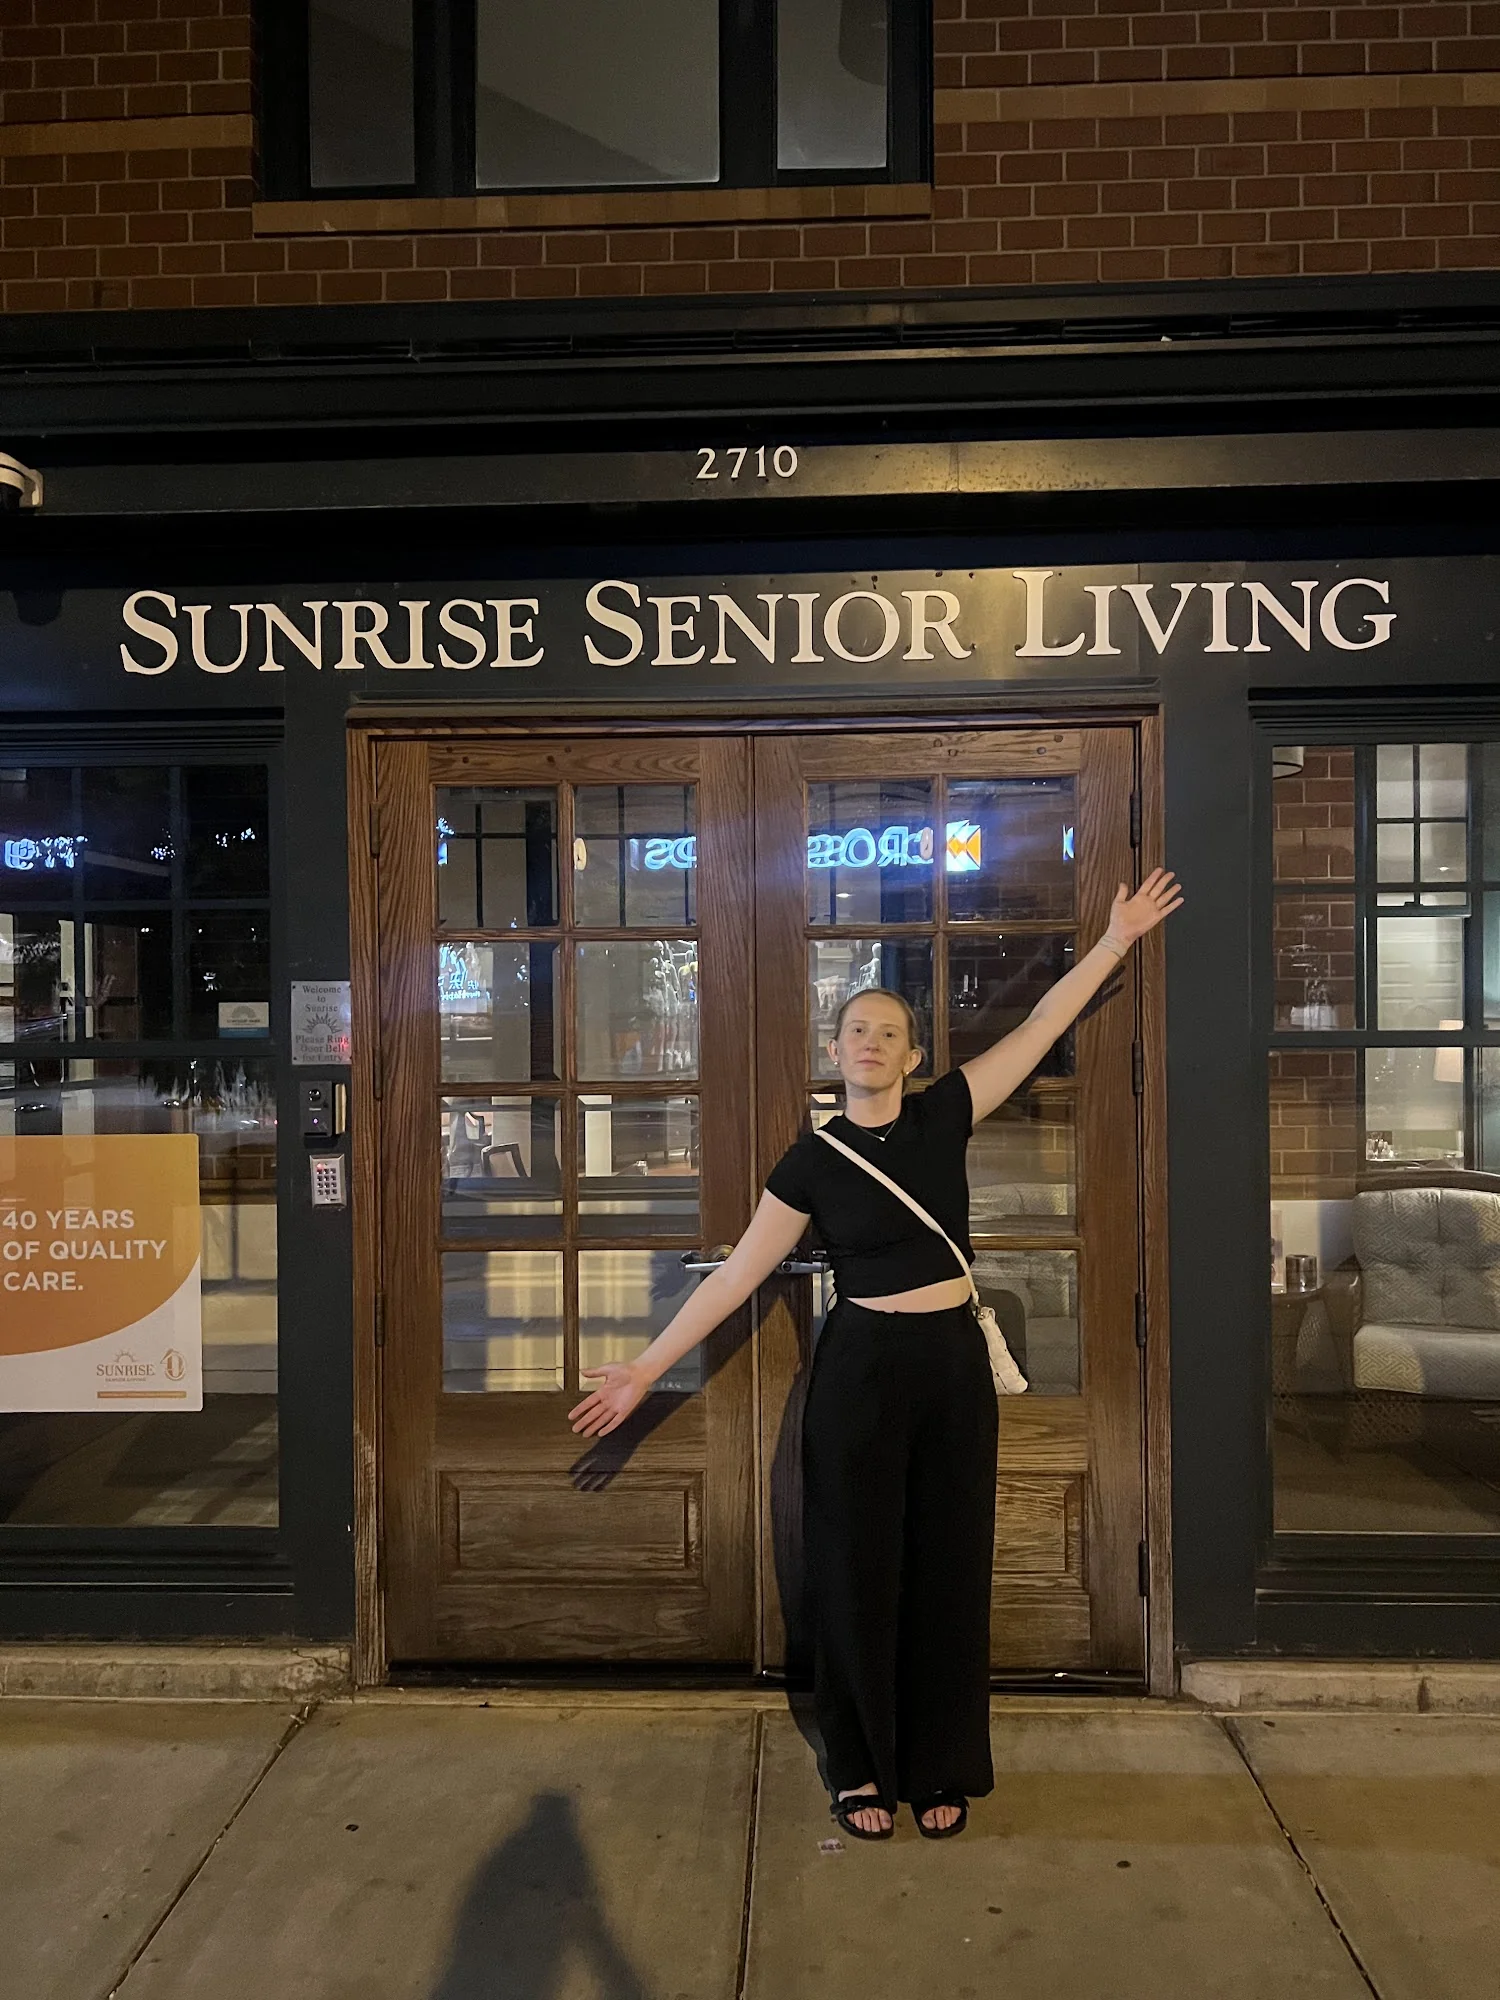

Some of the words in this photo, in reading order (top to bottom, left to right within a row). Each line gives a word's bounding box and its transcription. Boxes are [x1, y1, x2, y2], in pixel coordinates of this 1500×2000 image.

[696, 445, 798, 479] 2710
[120, 590, 545, 675] SUNRISE
[584, 580, 972, 667] SENIOR
[1012, 570, 1397, 657] LIVING
[302, 985, 342, 994] Welcome
[317, 995, 326, 1003] to
[304, 1004, 338, 1013] Sunrise
[295, 1034, 325, 1044] Please
[327, 1034, 349, 1045] Ring
[326, 1044, 345, 1053] Bell
[2, 1210, 37, 1230] 40
[46, 1209, 135, 1229] YEARS
[3, 1241, 40, 1261] OF
[49, 1239, 167, 1260] QUALITY
[3, 1271, 84, 1291] CARE.
[96, 1363, 156, 1376] SUNRISE
